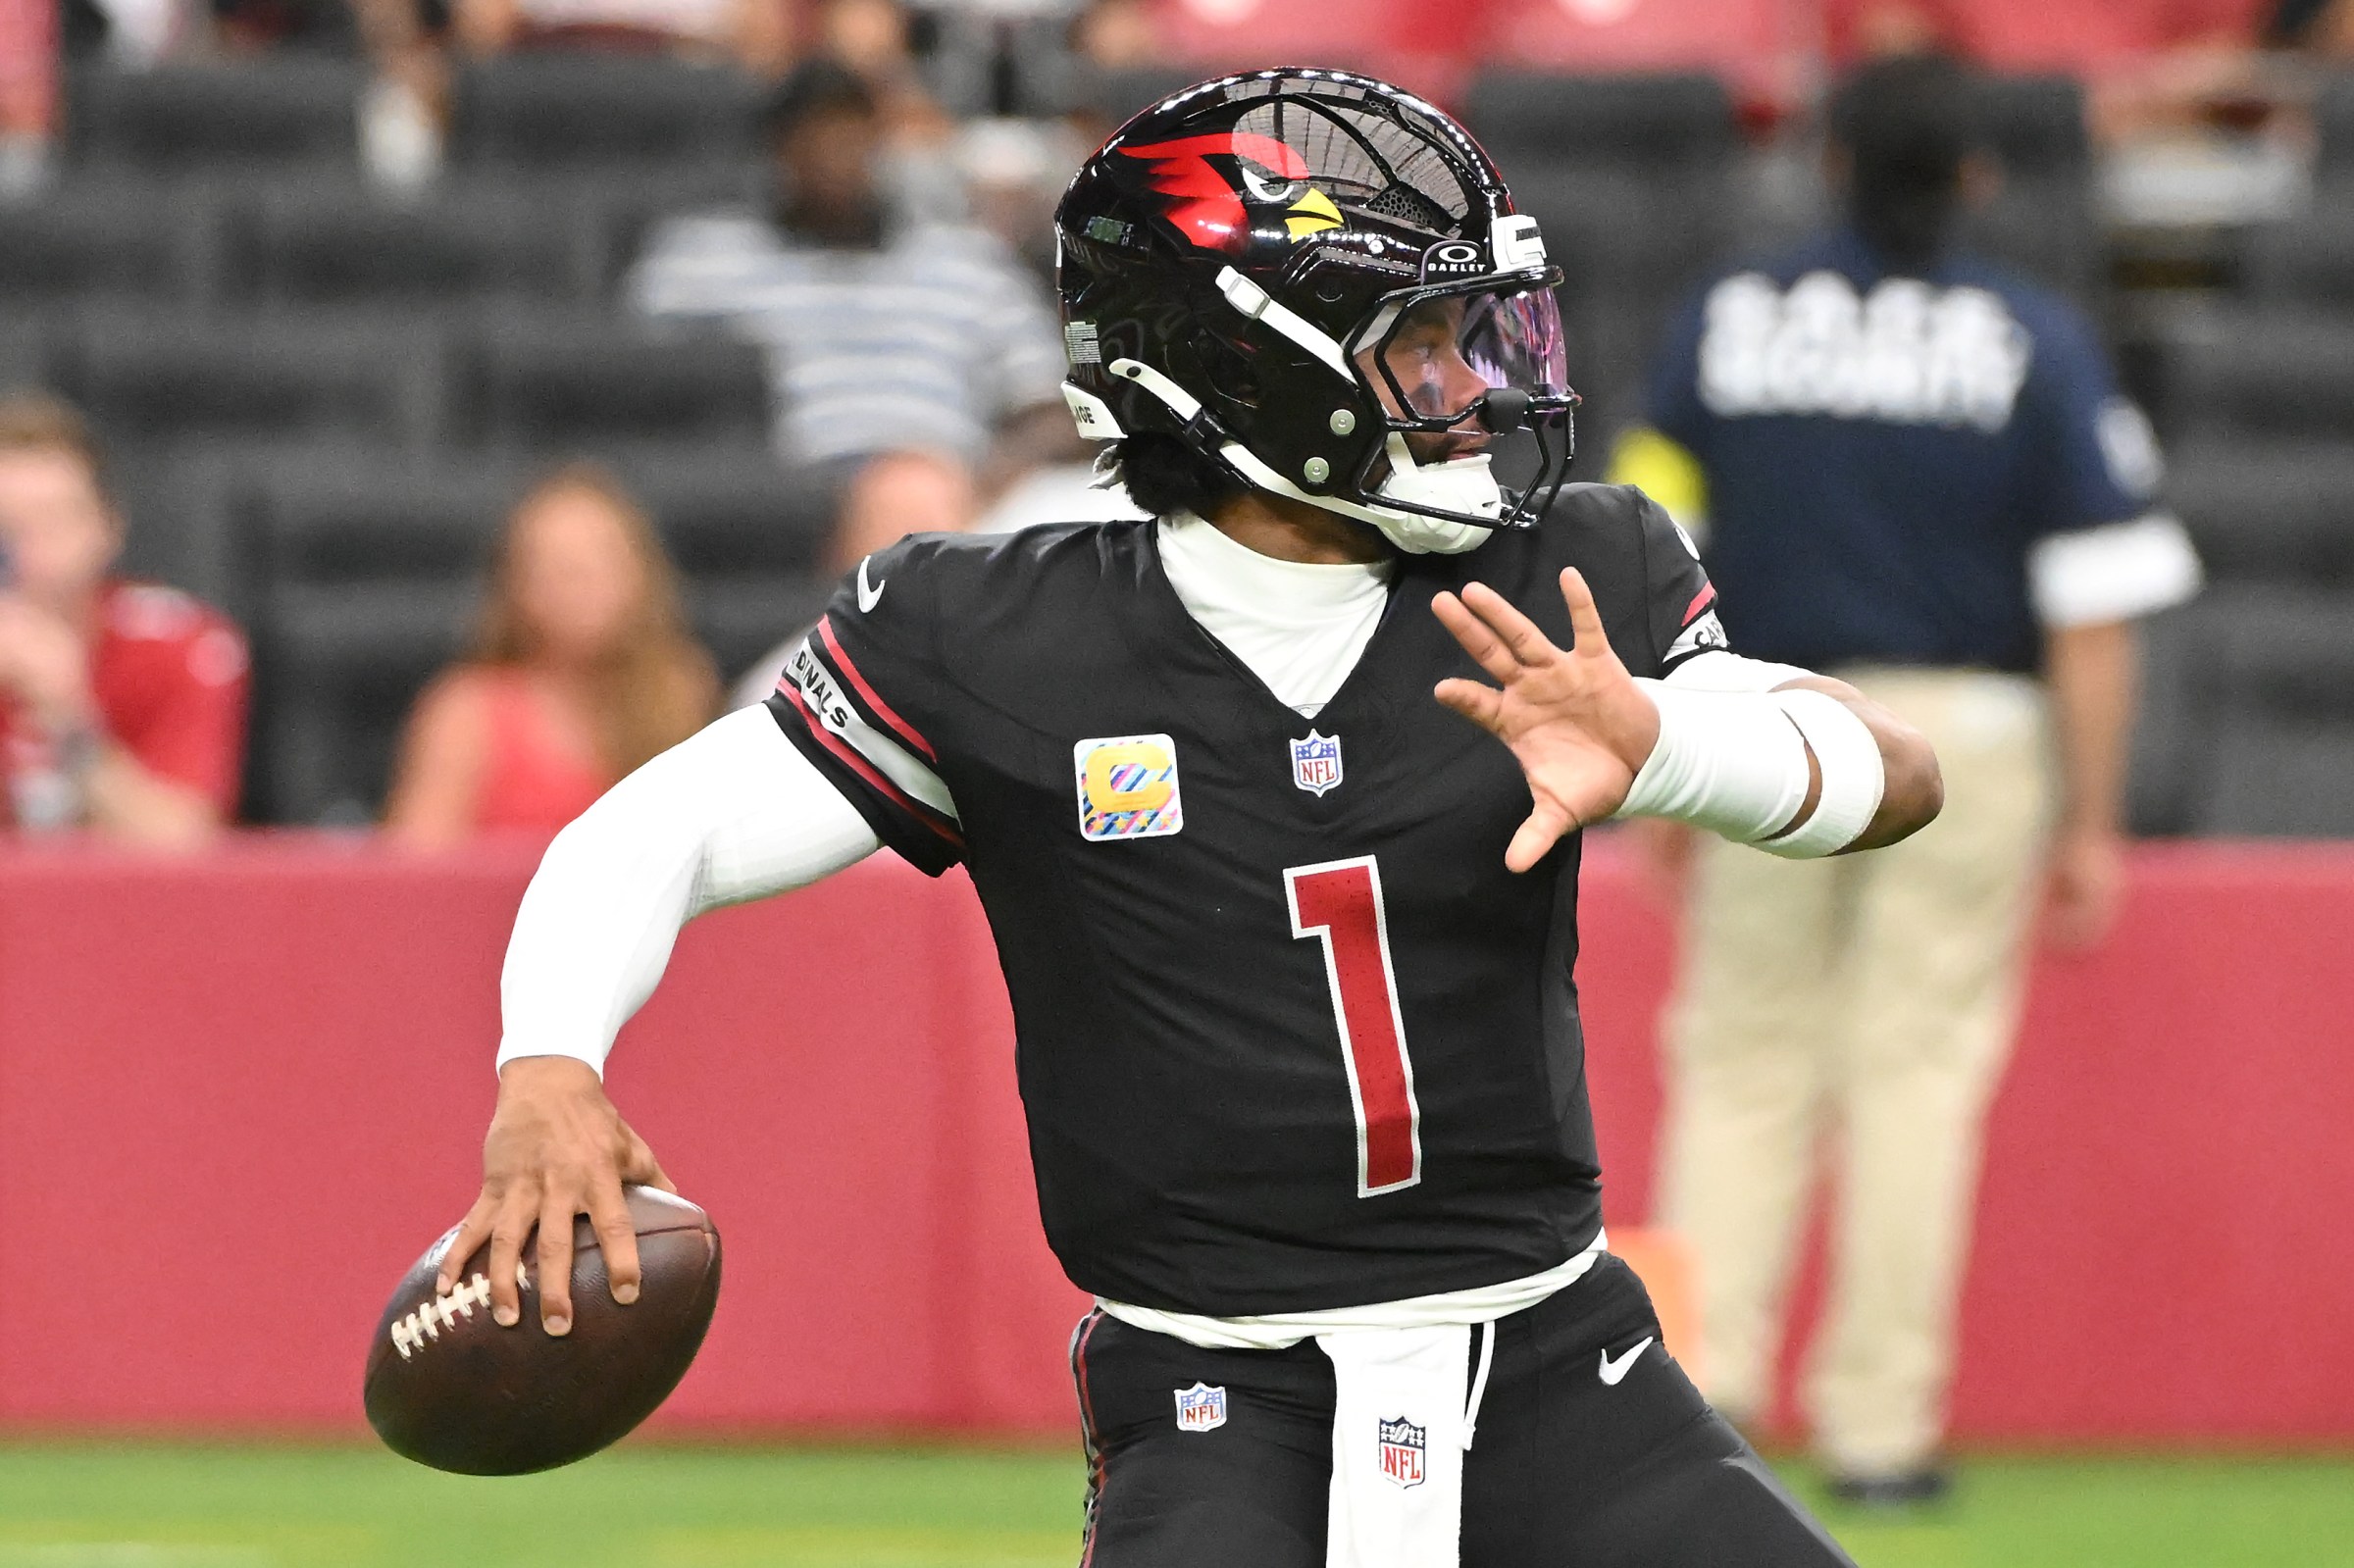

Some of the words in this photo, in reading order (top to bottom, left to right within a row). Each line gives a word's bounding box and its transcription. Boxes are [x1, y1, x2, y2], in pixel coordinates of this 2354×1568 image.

[1427, 263, 1487, 273] OAKLEY
[791, 649, 849, 729] DINALS
[1085, 743, 1173, 813] C
[1301, 760, 1335, 784] NFL
[1283, 854, 1421, 1198] 1
[1185, 1404, 1219, 1424] NFL
[1384, 1445, 1420, 1481] NFL
